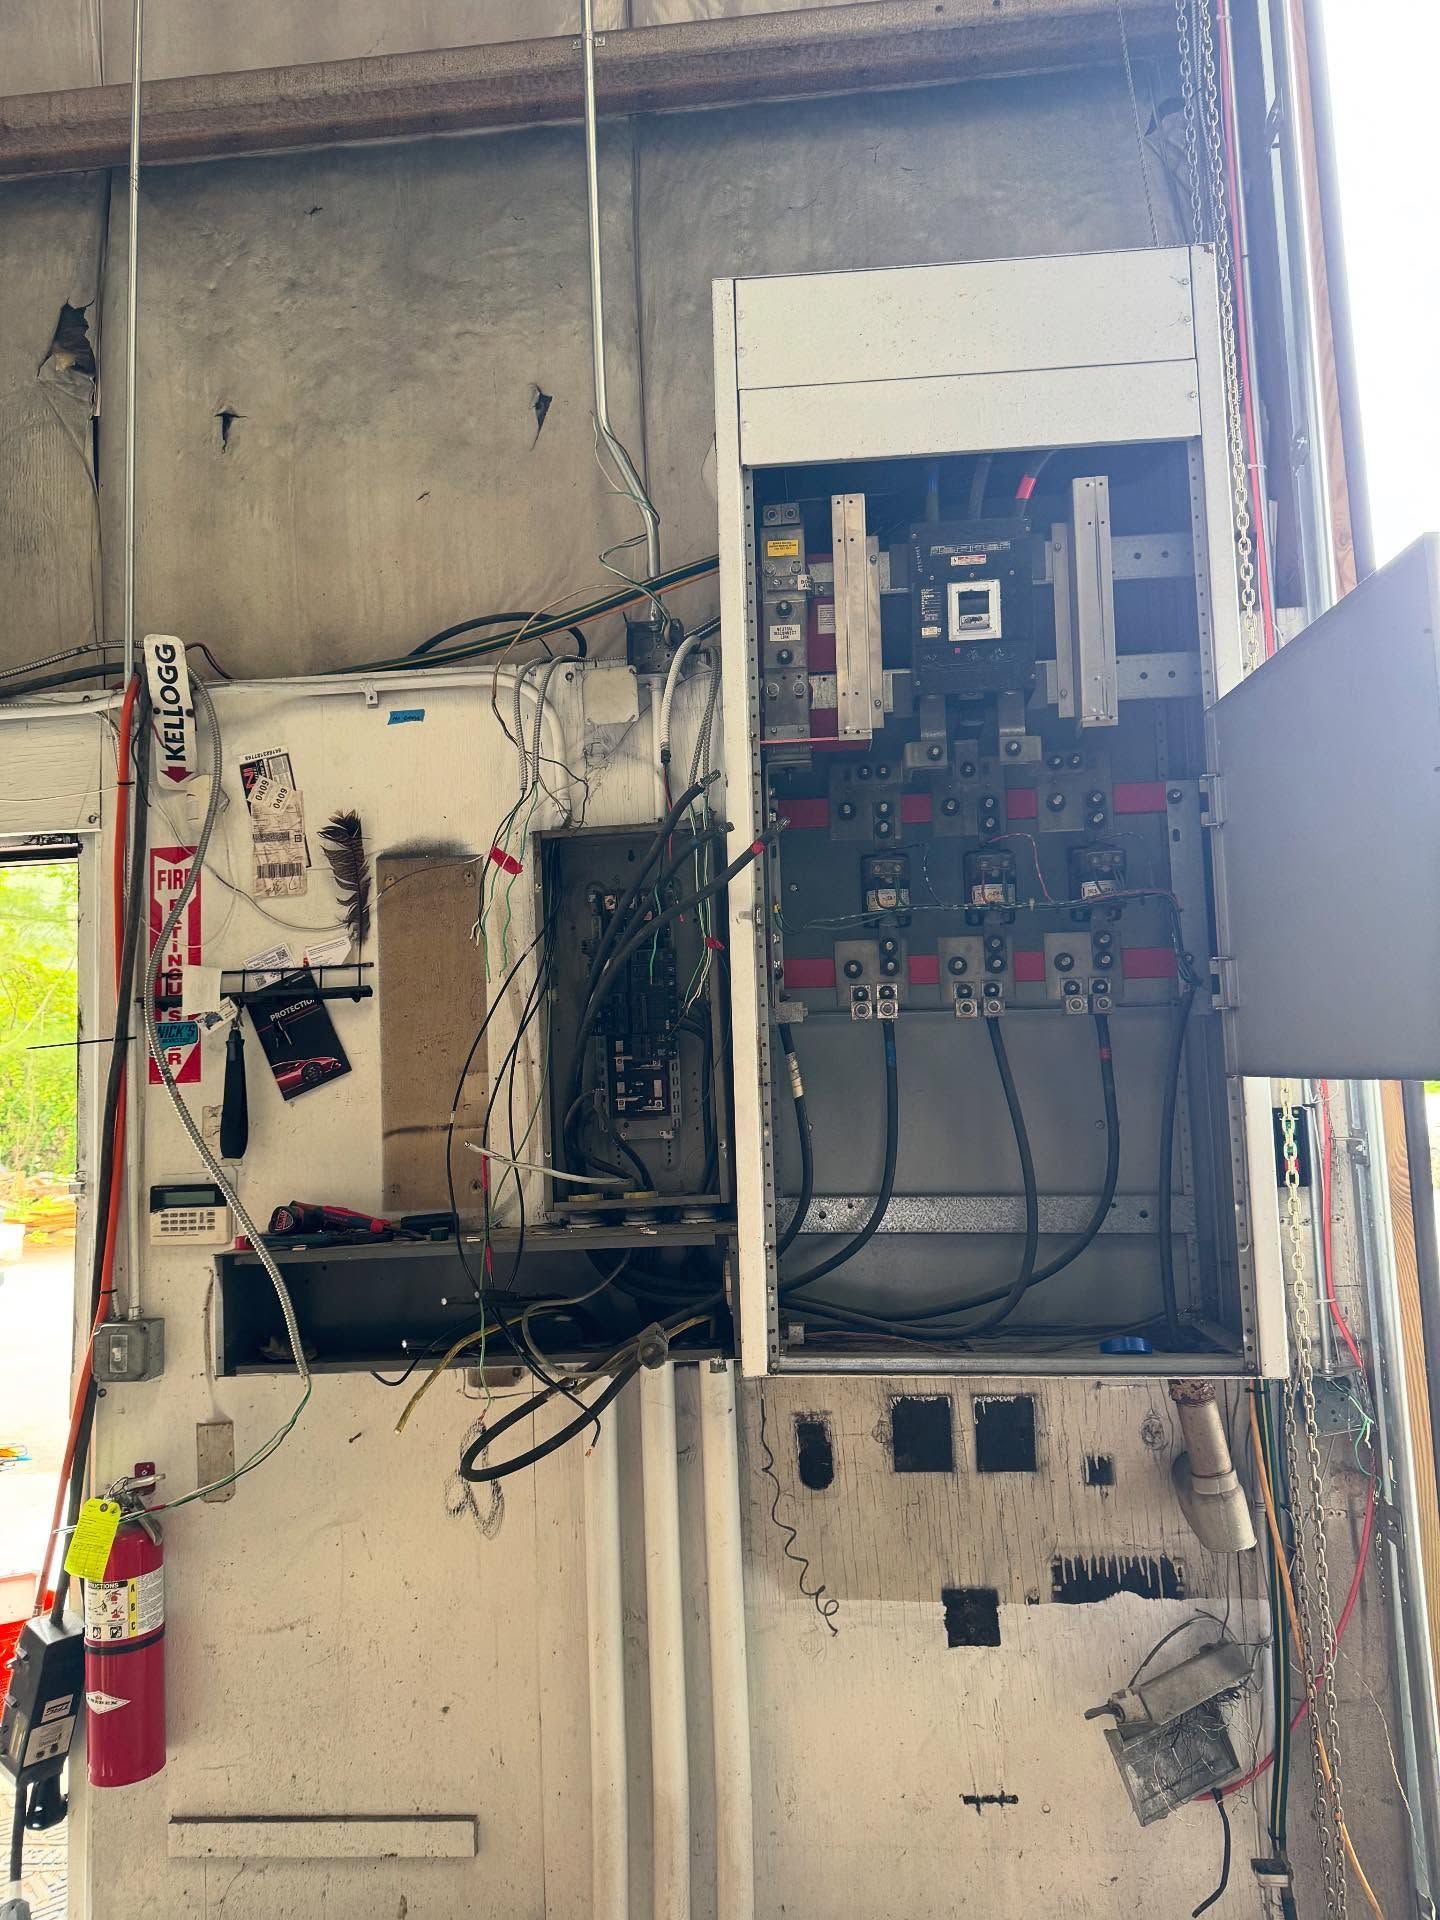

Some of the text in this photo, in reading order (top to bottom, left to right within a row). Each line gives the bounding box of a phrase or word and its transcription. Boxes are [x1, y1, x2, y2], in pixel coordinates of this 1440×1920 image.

[155, 643, 187, 761] KELLOGG
[255, 780, 269, 801] 0409
[273, 788, 288, 809] 0409
[270, 999, 316, 1022] PROTECTIO
[130, 1583, 135, 1592] A
[130, 1603, 135, 1612] B
[131, 1622, 136, 1630] C
